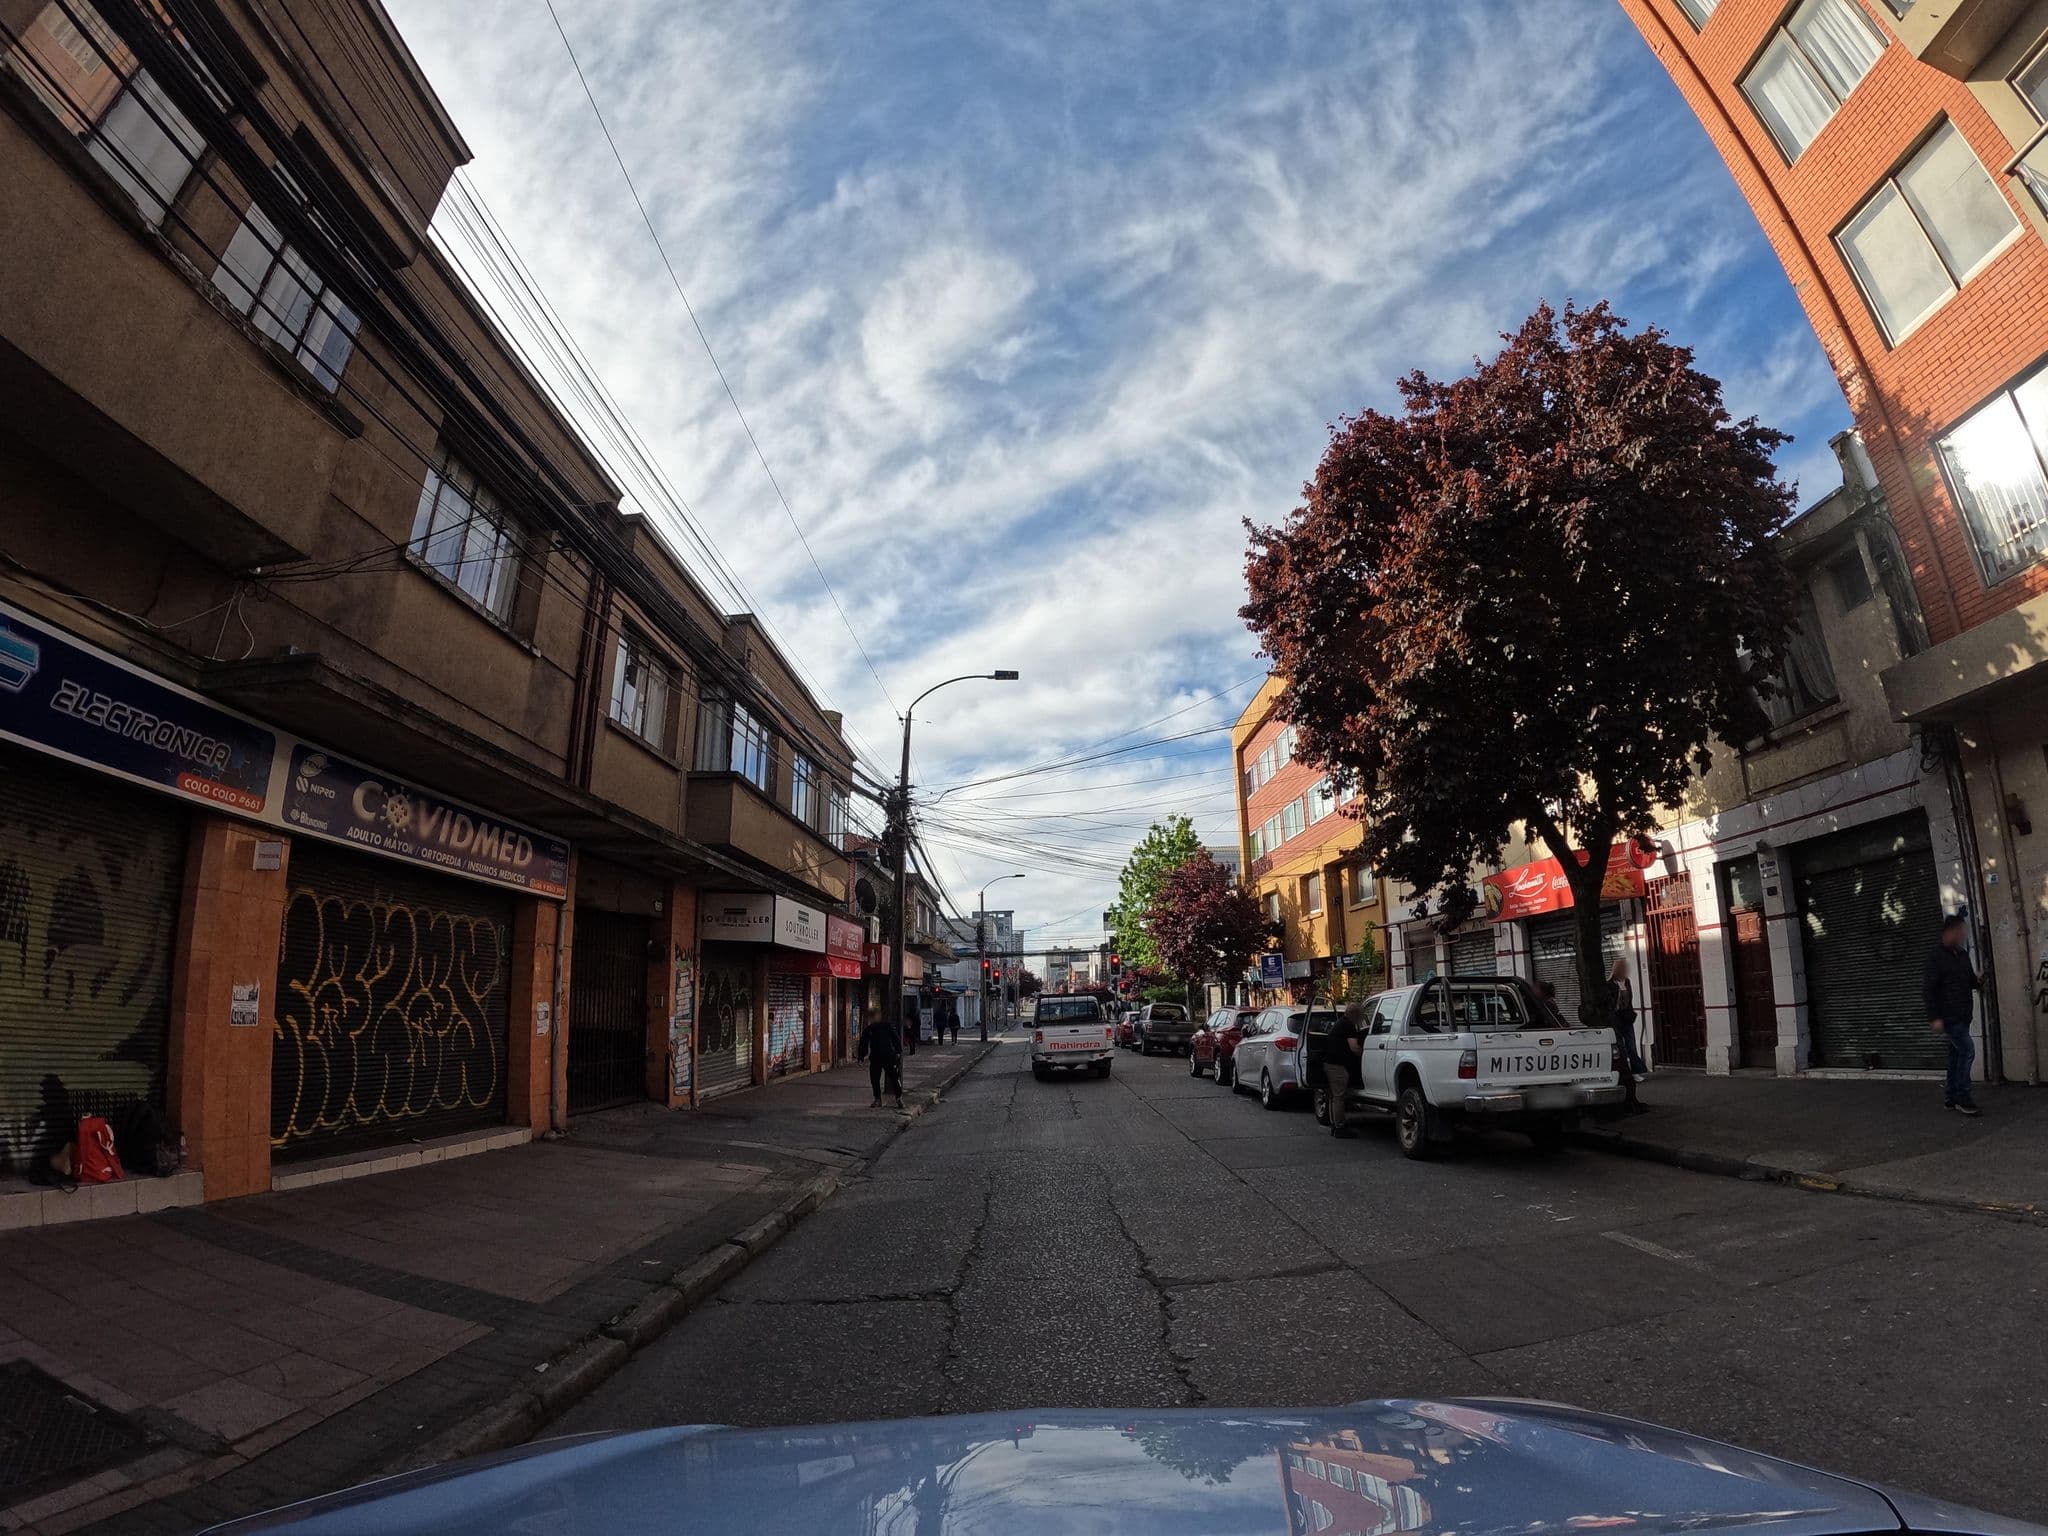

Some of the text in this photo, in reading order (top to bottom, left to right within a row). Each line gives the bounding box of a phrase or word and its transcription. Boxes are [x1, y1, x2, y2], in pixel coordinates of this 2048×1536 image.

[50, 679, 232, 768] ELECTRONICA
[184, 778, 261, 810] COLO COLO #661
[310, 783, 336, 799] NIPRO
[346, 826, 382, 845] ADULTO
[421, 848, 462, 868] ORTOPEDIA
[467, 860, 498, 878] INSUMOS
[499, 869, 526, 885] MEDICOS
[1049, 1041, 1101, 1050] Mahindra
[1491, 1053, 1600, 1073] MITSUBISHI
